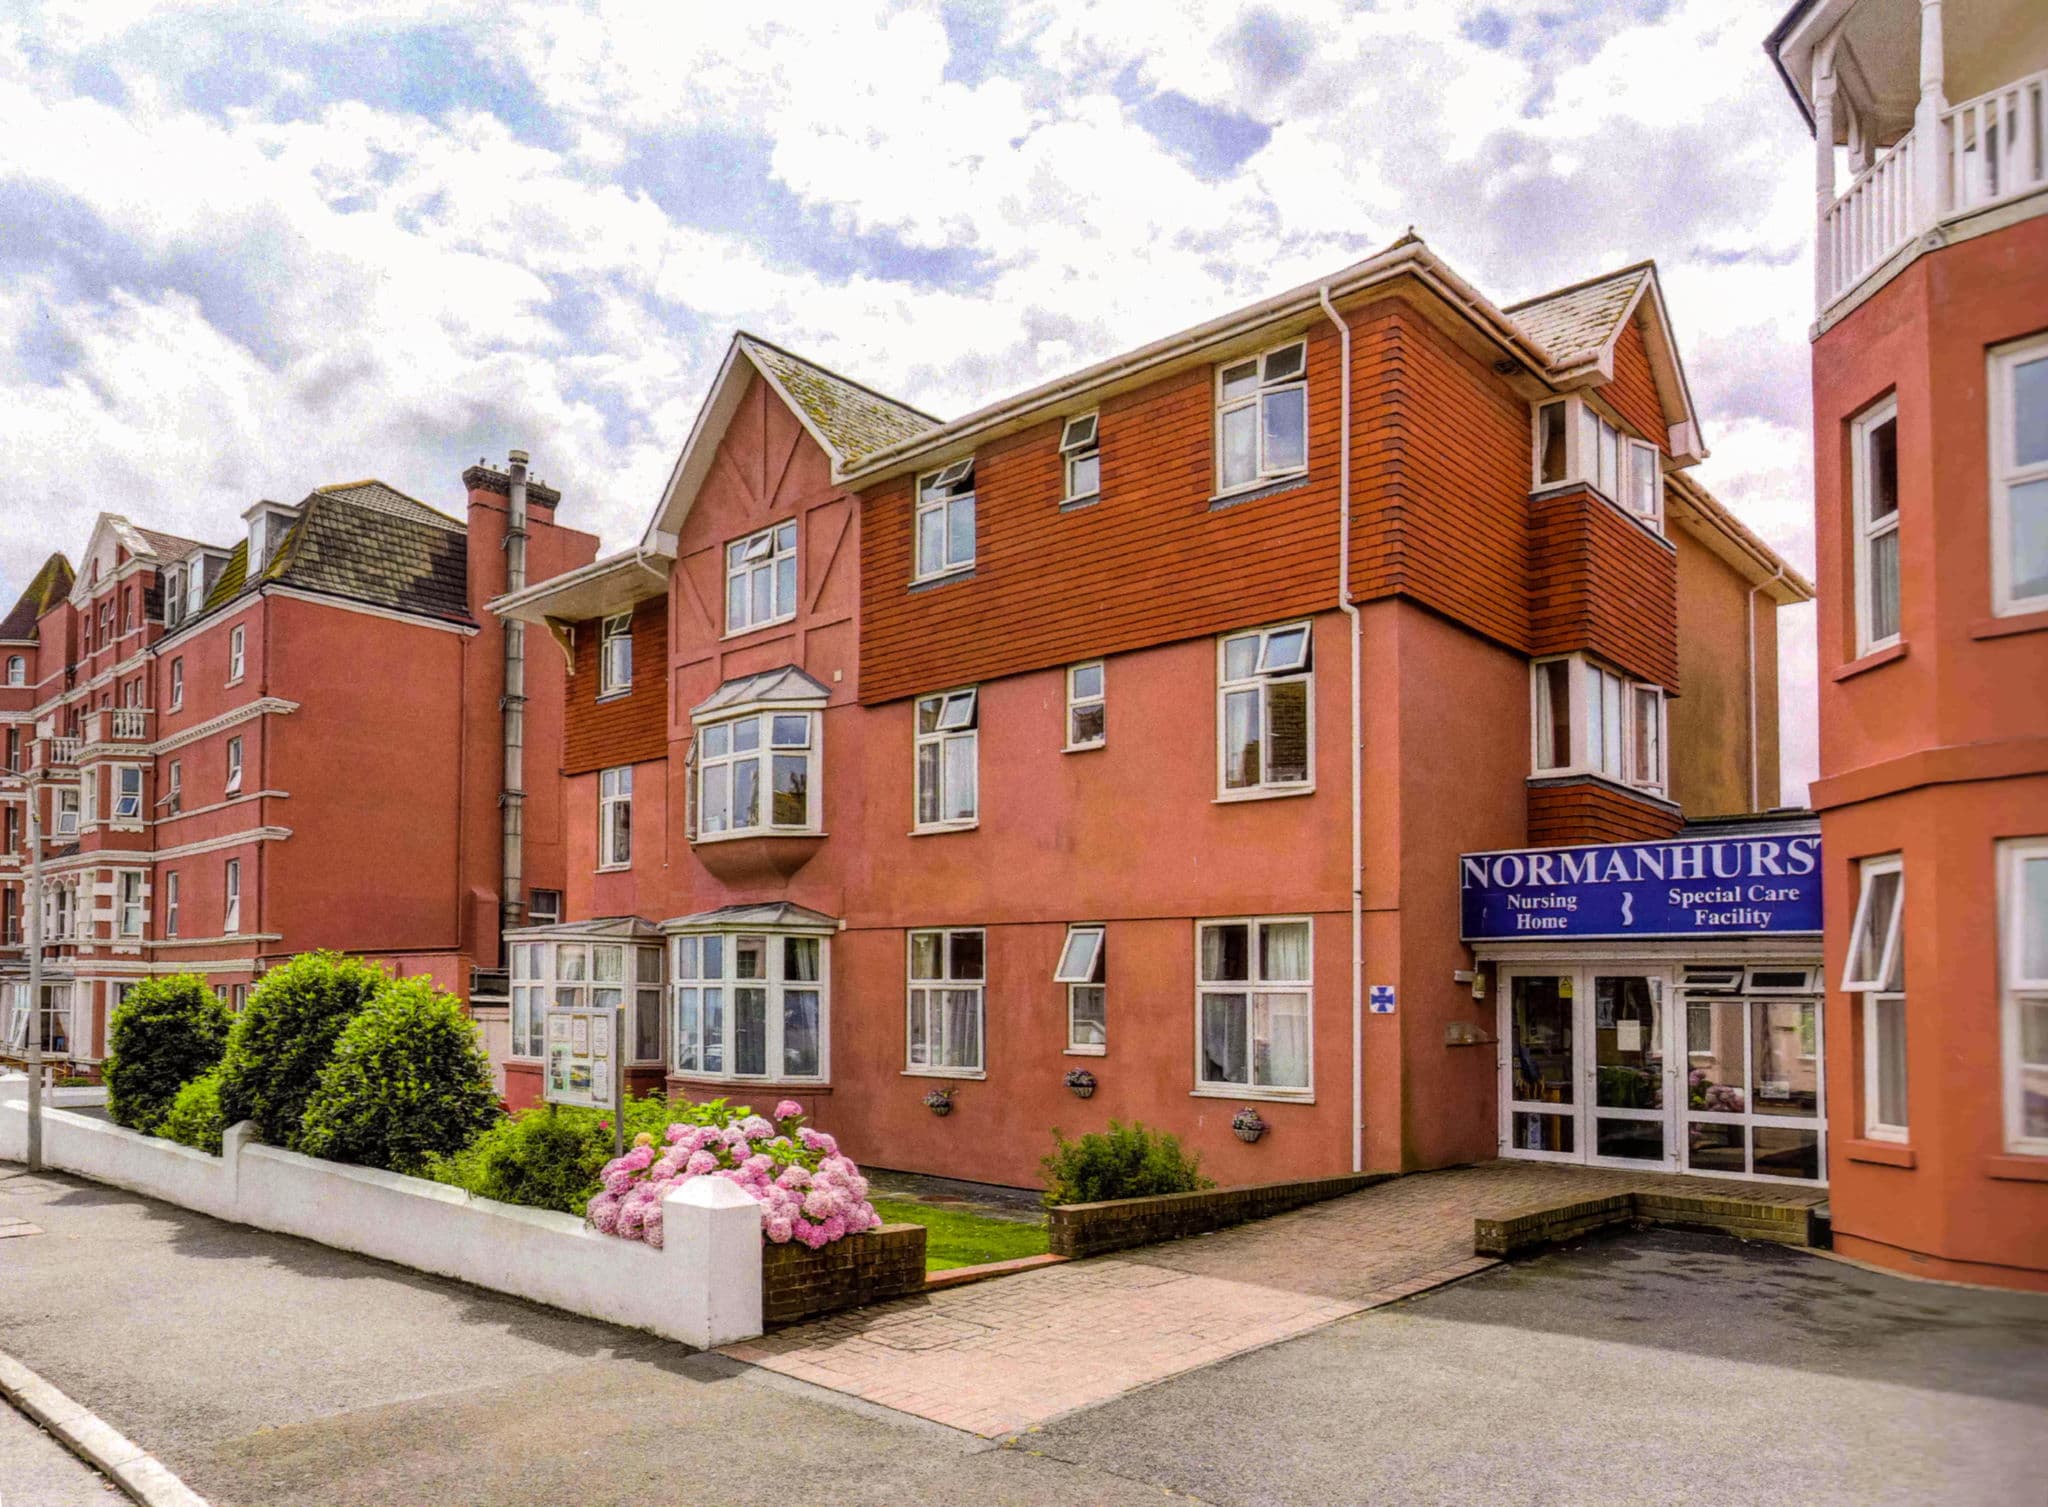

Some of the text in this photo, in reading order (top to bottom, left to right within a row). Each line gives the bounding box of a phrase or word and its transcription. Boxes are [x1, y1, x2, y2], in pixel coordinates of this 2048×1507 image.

[1462, 838, 1822, 889] NORMANHURS
[1507, 892, 1578, 912] Nursing
[1668, 885, 1800, 908] Special Care
[1516, 913, 1568, 930] Home
[1694, 908, 1772, 928] Facility
